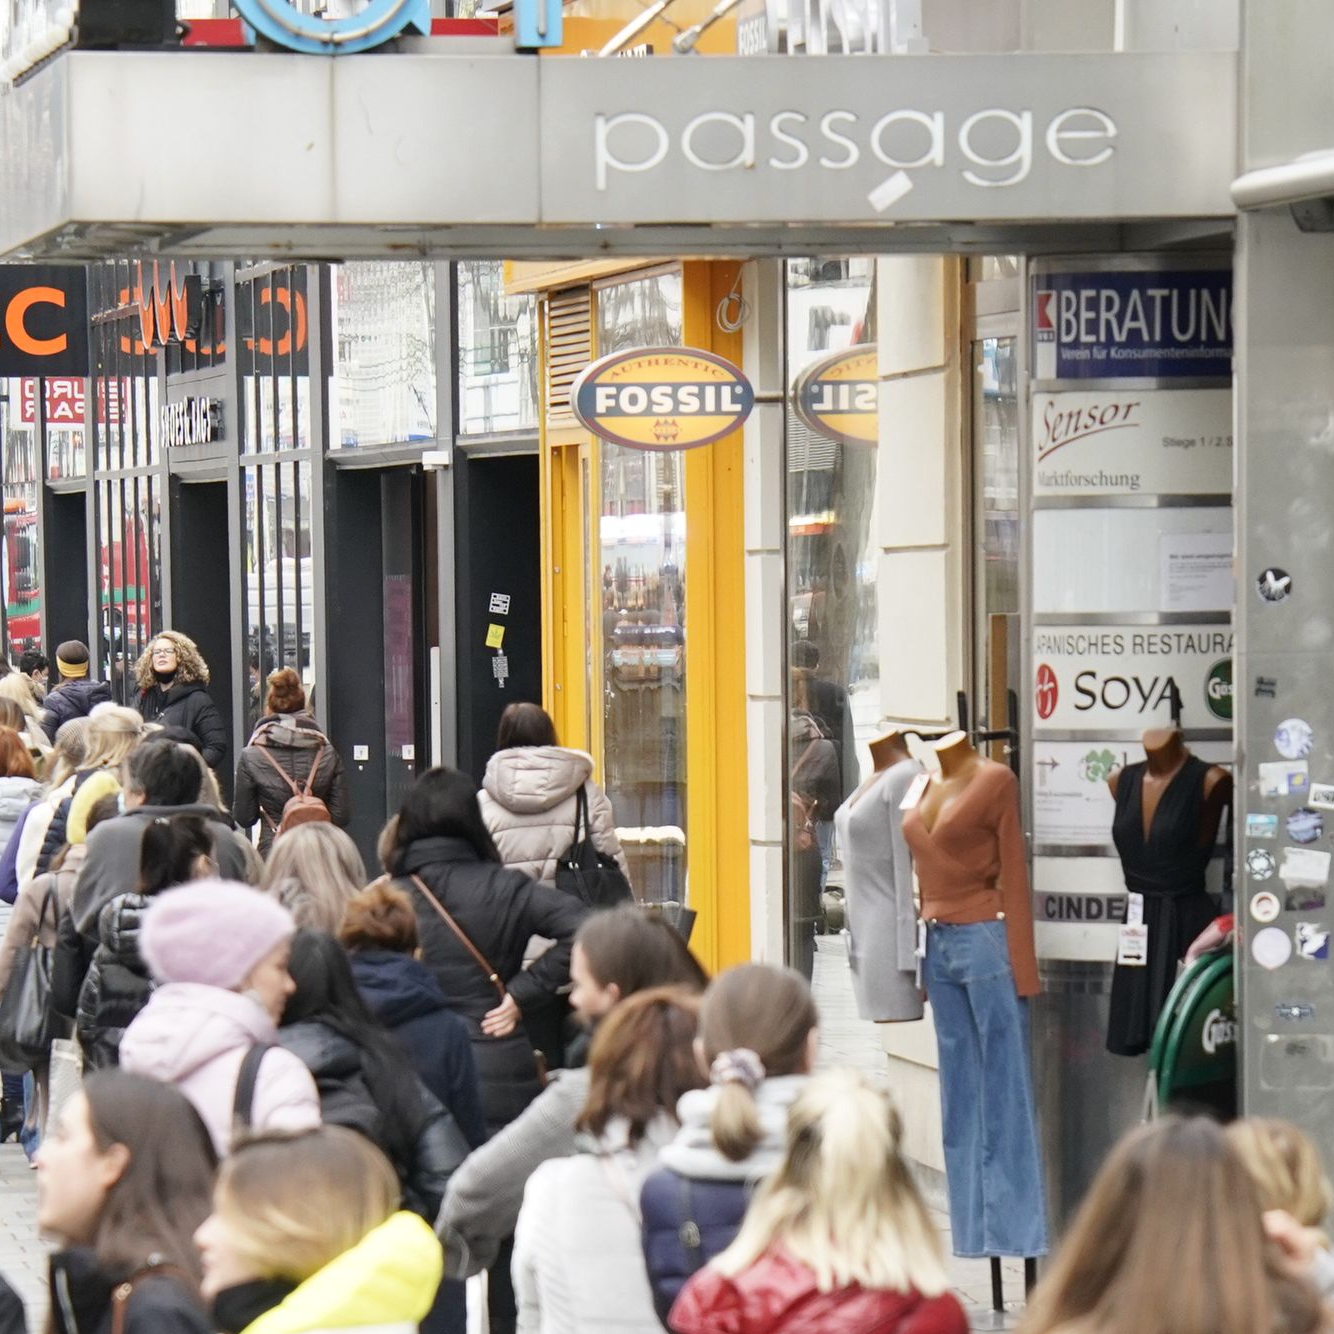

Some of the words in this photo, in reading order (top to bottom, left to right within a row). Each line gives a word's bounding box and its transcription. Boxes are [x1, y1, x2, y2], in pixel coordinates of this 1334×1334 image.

[595, 107, 1117, 191] passage
[1060, 288, 1232, 343] BERATUN
[610, 356, 727, 380] AUTHENTIC
[1061, 346, 1091, 360] Verein
[1093, 345, 1108, 360] für
[595, 385, 742, 414] FOSSIL
[1038, 400, 1141, 451] Sensor
[1074, 670, 1176, 714] SOYA
[1045, 895, 1125, 919] CINDE
